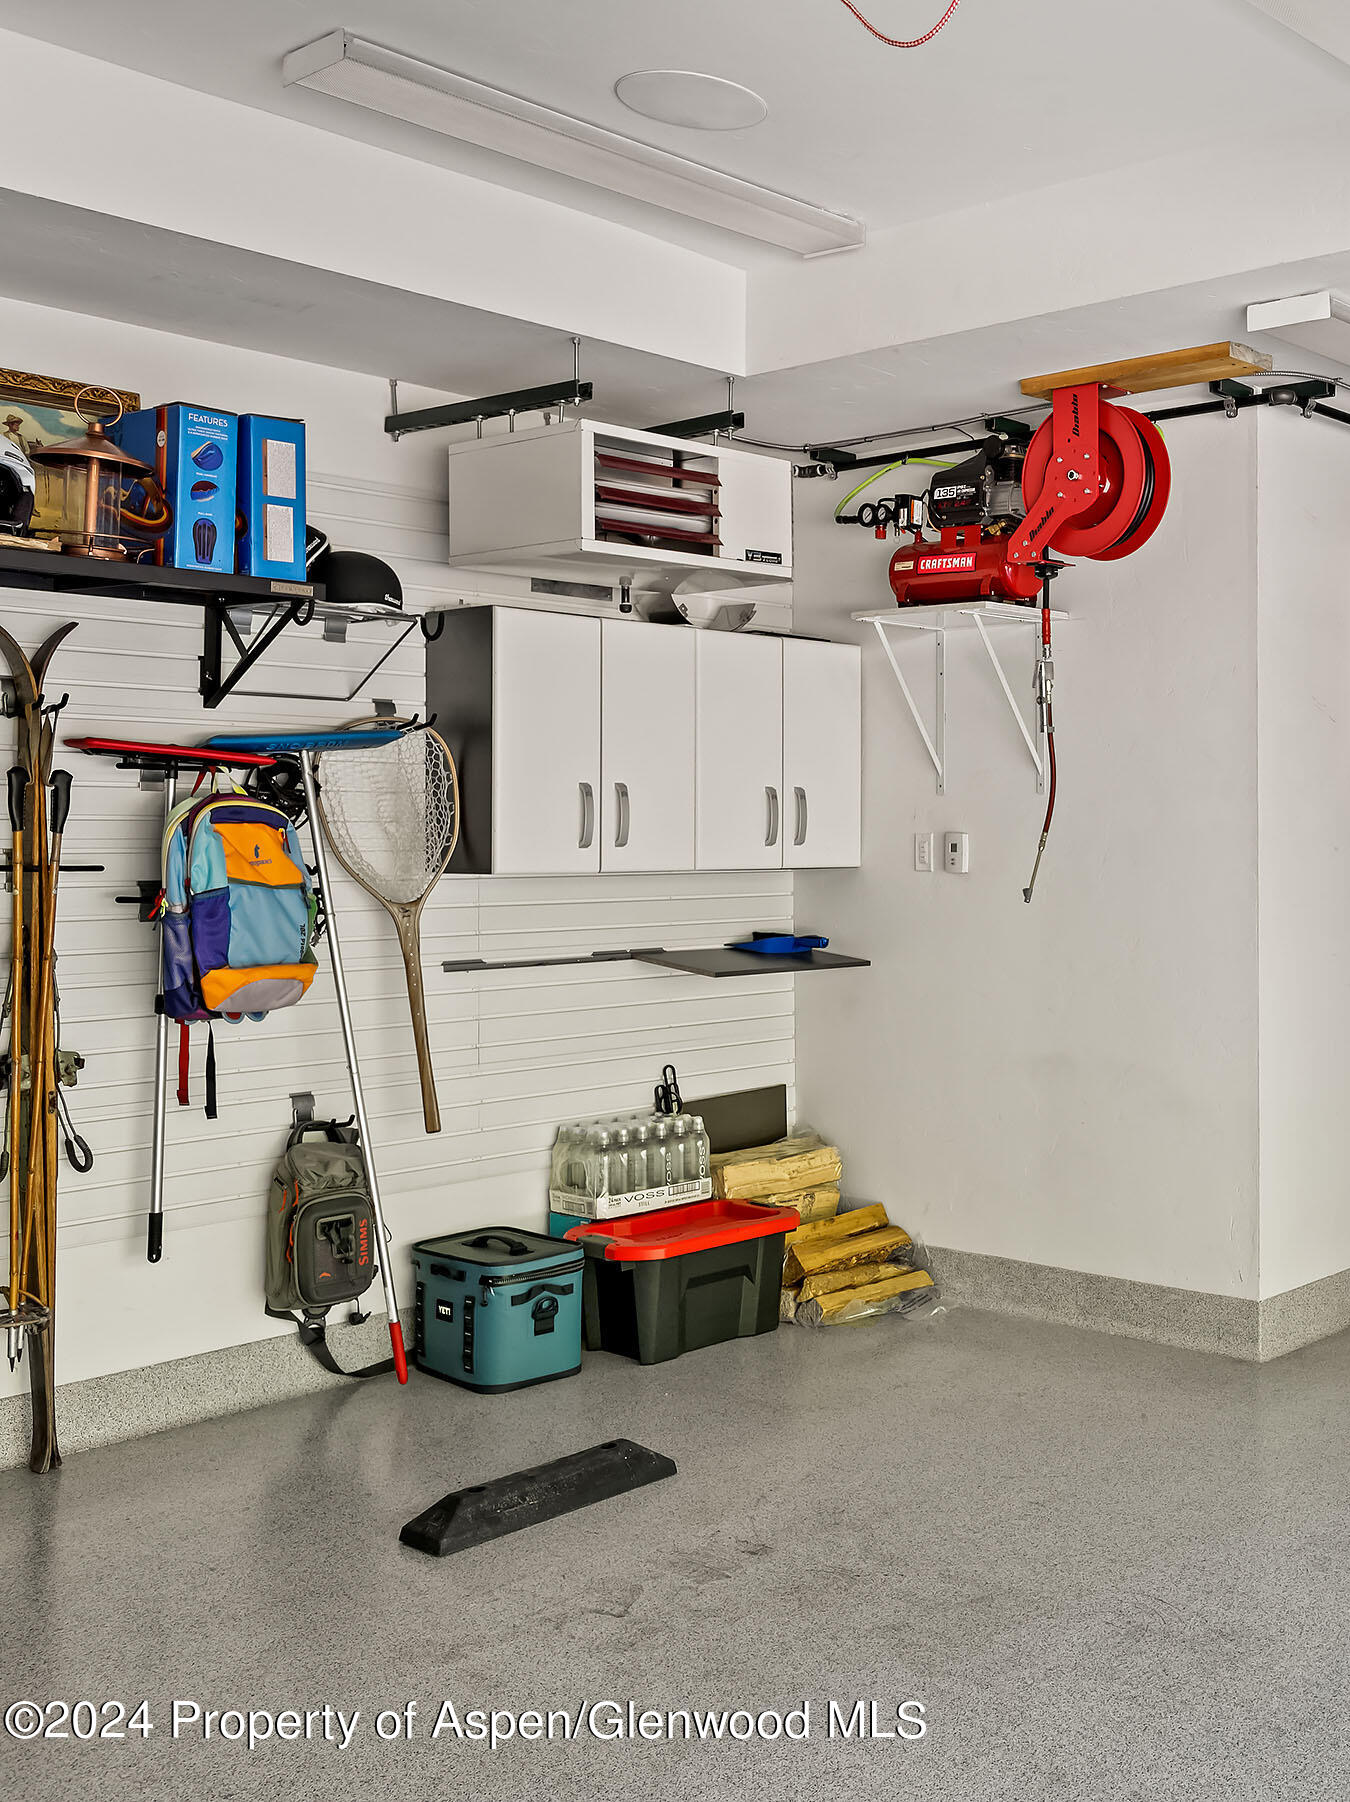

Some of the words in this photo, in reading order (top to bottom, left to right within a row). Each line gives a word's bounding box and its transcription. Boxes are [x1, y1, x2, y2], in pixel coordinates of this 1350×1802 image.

[188, 412, 228, 427] FEATURES
[1072, 393, 1080, 437] Diablo
[937, 487, 956, 498] 135
[1029, 506, 1055, 542] Diablo
[920, 556, 973, 570] CRAFTSMAN
[624, 1189, 665, 1203] VOSS
[358, 1218, 369, 1266] SIMMS
[438, 1305, 451, 1316] YETI
